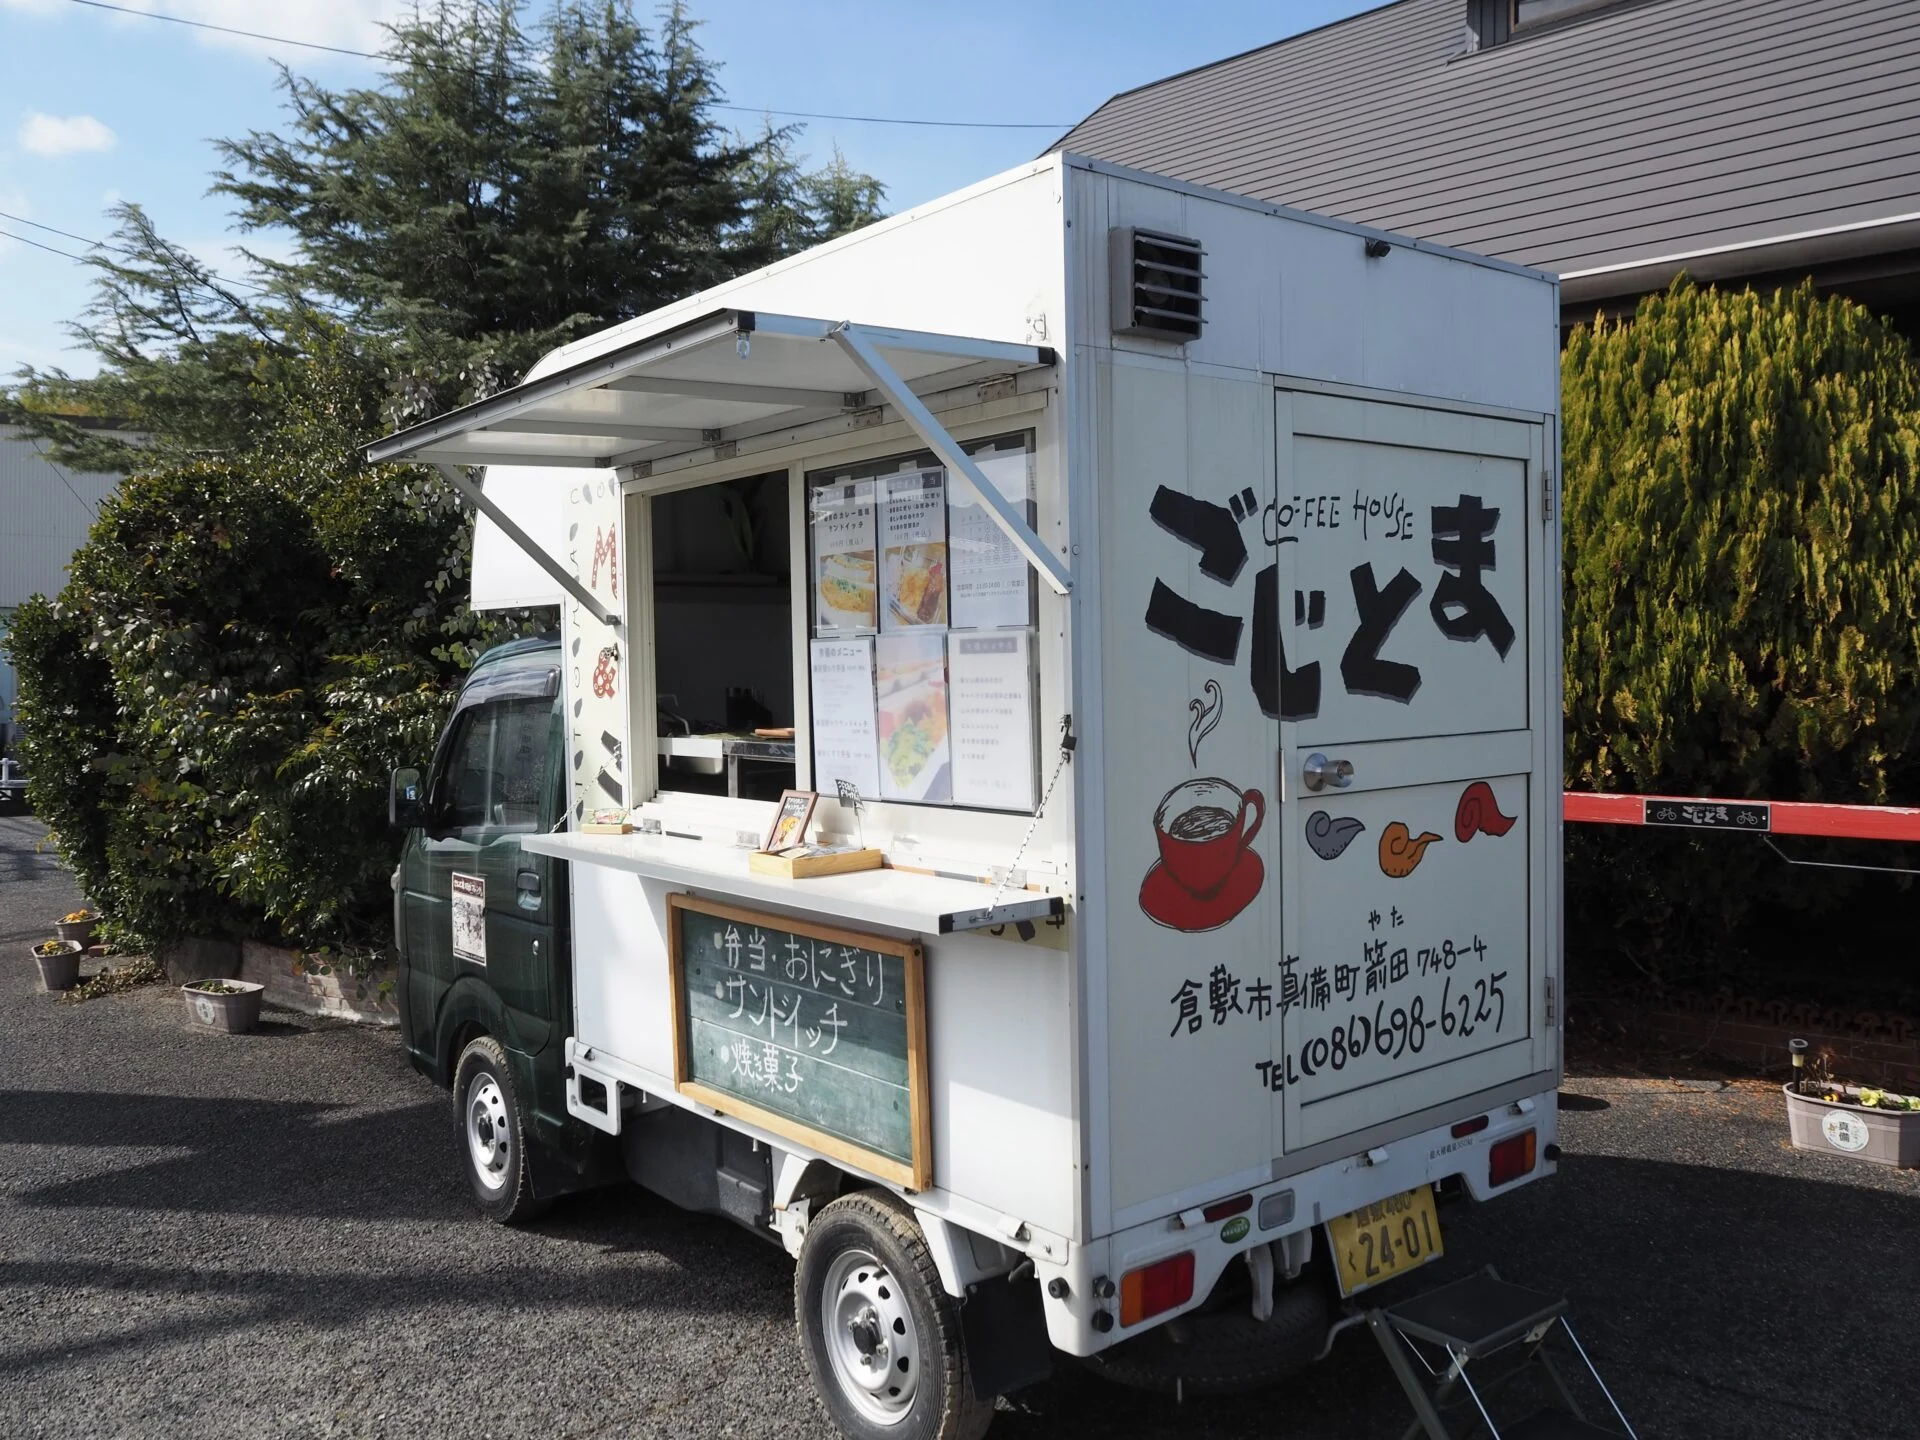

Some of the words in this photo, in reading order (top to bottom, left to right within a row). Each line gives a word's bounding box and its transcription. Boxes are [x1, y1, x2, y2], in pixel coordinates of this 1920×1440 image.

[1262, 495, 1341, 547] COFFEE
[1353, 489, 1414, 541] HOUSE
[1145, 485, 1515, 722] ごじとま
[1682, 805, 1729, 824] ごじとま
[1368, 905, 1404, 931] やた
[726, 974, 848, 1055] サンドイッチ
[731, 1038, 804, 1093] 焼き菓子
[1348, 1250, 1357, 1272] く
[1358, 1210, 1433, 1278] 24-01
